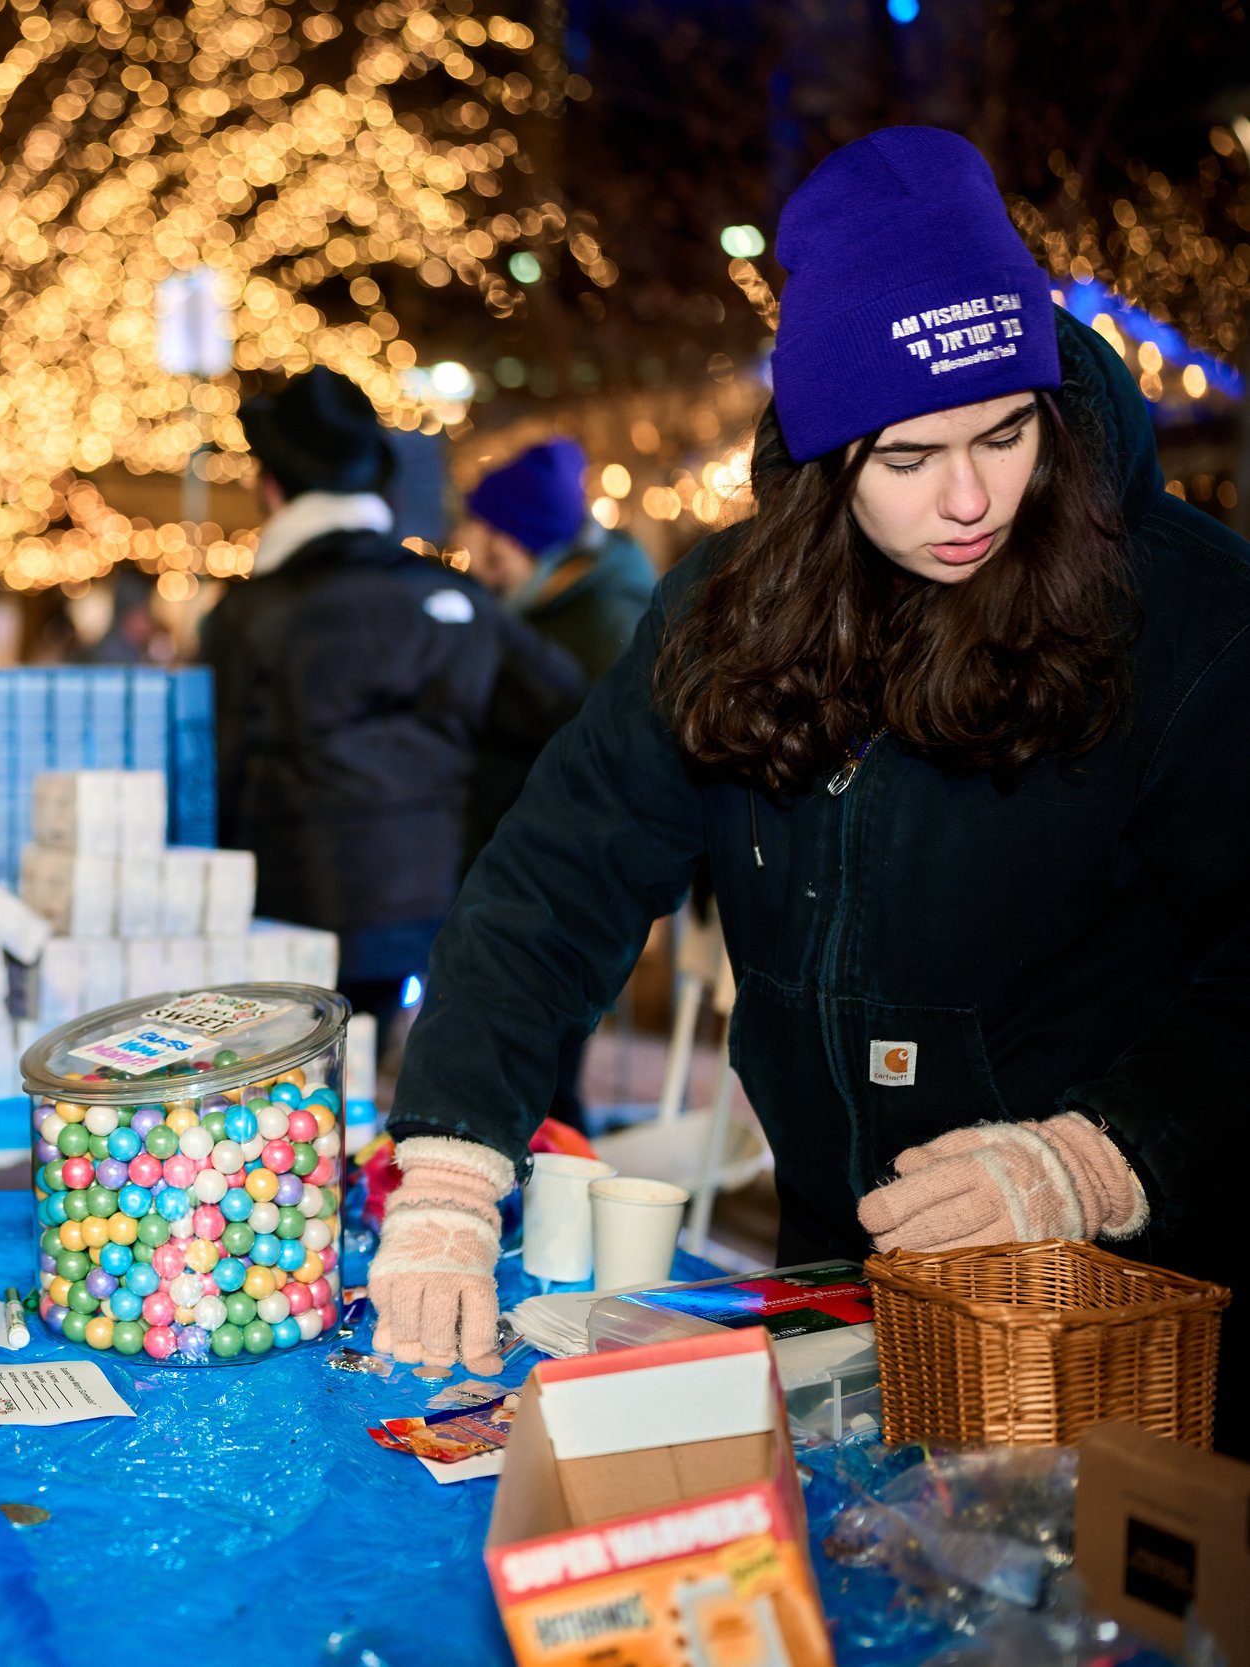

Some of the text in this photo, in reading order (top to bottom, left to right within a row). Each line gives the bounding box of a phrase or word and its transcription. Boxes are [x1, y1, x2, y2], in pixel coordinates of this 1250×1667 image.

[891, 316, 921, 339] AM
[919, 298, 994, 330] YISRAEL
[147, 1008, 235, 1030] SWEET
